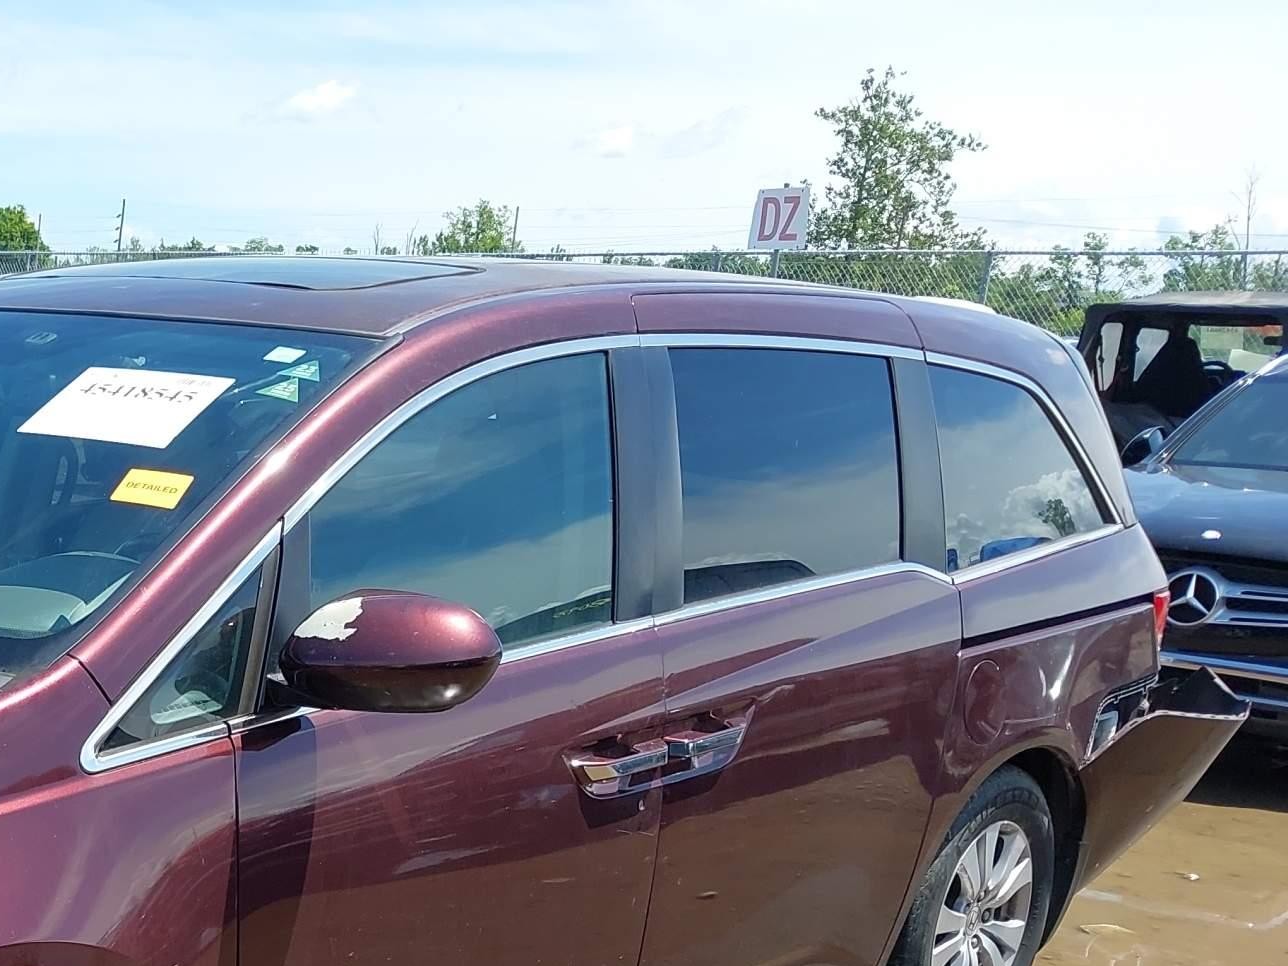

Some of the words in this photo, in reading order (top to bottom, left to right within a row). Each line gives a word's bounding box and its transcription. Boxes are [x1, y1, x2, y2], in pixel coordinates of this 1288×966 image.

[757, 196, 801, 241] DZ
[80, 383, 198, 403] 45418545
[126, 481, 178, 494] DETAILED
